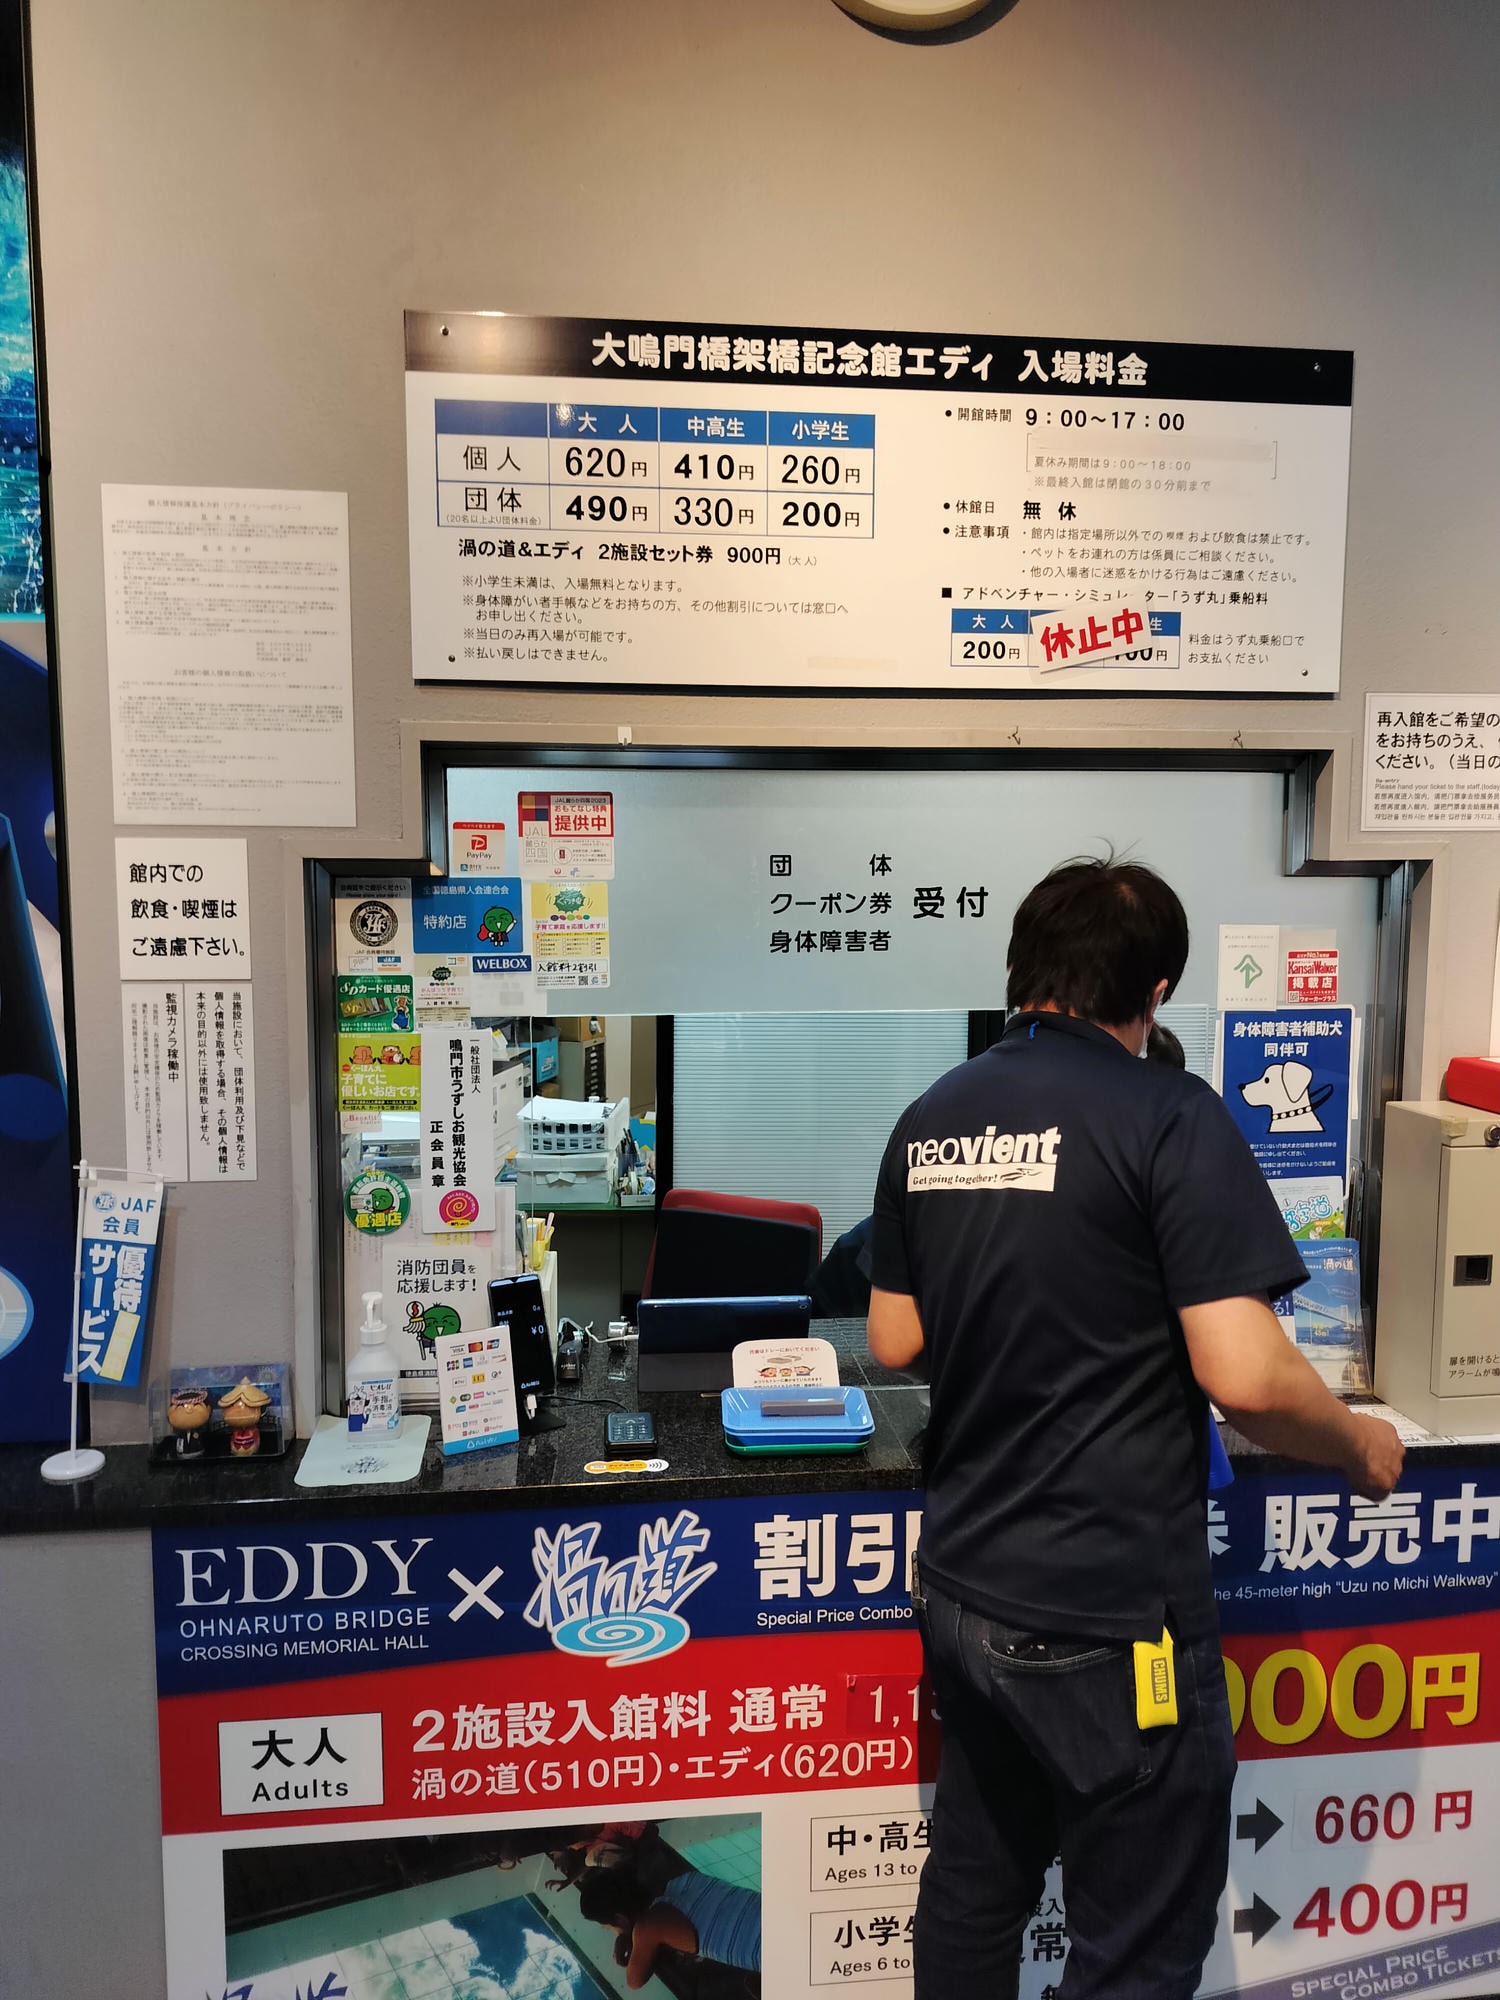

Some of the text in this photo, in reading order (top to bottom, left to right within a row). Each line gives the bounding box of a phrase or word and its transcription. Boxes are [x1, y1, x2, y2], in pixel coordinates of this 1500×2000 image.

[592, 331, 1149, 387] 大鳴門橋架橋記念館エディ 入場料金
[578, 411, 638, 435] 大人
[957, 406, 1012, 423] 開館時間
[687, 416, 746, 438] 中高生
[791, 420, 850, 442] 小学生
[463, 446, 522, 473] 個人
[464, 486, 523, 514] 団体
[956, 499, 1077, 521] 休館日 無休
[955, 523, 1010, 540] 注意事項
[458, 539, 585, 561] 渦の道&エディ
[599, 543, 714, 564] 2施設セット券
[727, 547, 782, 567] 900円
[476, 609, 584, 625] お申し出ください。
[972, 614, 1015, 629] 大人
[1040, 608, 1144, 663] 休止中
[963, 640, 1020, 661] 200円
[1188, 652, 1269, 665] お支払ください
[1376, 711, 1500, 728] 再入館をご希望の
[1375, 754, 1435, 770] ください。
[554, 815, 607, 831] 提供中
[466, 852, 492, 860] PayPay
[129, 863, 204, 884] 館内での
[130, 898, 238, 920] 飲食・喫煙は
[770, 885, 989, 919] クーポン券 受付
[423, 914, 467, 930] 特約店
[132, 936, 246, 957] ご遠慮下さい。
[769, 930, 892, 953] 身体障害者
[476, 958, 528, 970] WELBOX
[1292, 977, 1333, 989] 掲載店
[165, 992, 180, 1083] 監視カメラ稼働中
[1233, 1020, 1343, 1038] 身体障害者補助犬
[1264, 1042, 1309, 1057] 同伴可
[470, 1039, 481, 1094] 一般社団法人
[341, 1073, 388, 1085] 子育てに
[341, 1085, 421, 1098] 優しいお店です。
[449, 1038, 467, 1188] 鳴門市うずしお観光協会
[430, 1120, 446, 1188] 正会員章
[907, 1125, 1062, 1168] neovient
[912, 1172, 998, 1186] Get going together!
[121, 1197, 157, 1214] JAF
[102, 1216, 140, 1236] 会員
[355, 1211, 403, 1229] 優遇店
[396, 1258, 476, 1276] 消防団員を
[112, 1244, 147, 1314] 優待
[396, 1278, 478, 1294] 応援します!
[76, 1242, 117, 1376] サービス
[1448, 1354, 1500, 1367] 扉を開けると
[175, 1537, 433, 1607] EDDY
[1214, 1587, 1231, 1601] he
[1235, 1583, 1299, 1599] 45-meter
[1302, 1580, 1332, 1598] high
[1372, 1580, 1390, 1591] no
[1393, 1575, 1429, 1591] Michi
[179, 1606, 431, 1639] OHNARUTO BRIDGE
[756, 1605, 913, 1629] Special Price Combo
[180, 1634, 429, 1662] CROSSING MEMORIAL HALL
[1153, 1658, 1169, 1704] CHUMS
[412, 1689, 711, 1754] 2施設入館料
[728, 1683, 827, 1735] 通常
[251, 1726, 348, 1772] 大人
[252, 1777, 349, 1803] Adults
[824, 1862, 918, 1884] Ages 13 to
[1293, 1879, 1468, 1938] 400円
[829, 1956, 911, 1977] Ages 6 to
[1290, 1946, 1450, 1999] SPECIAL PRICE
[1339, 1971, 1418, 2000] COMBO
